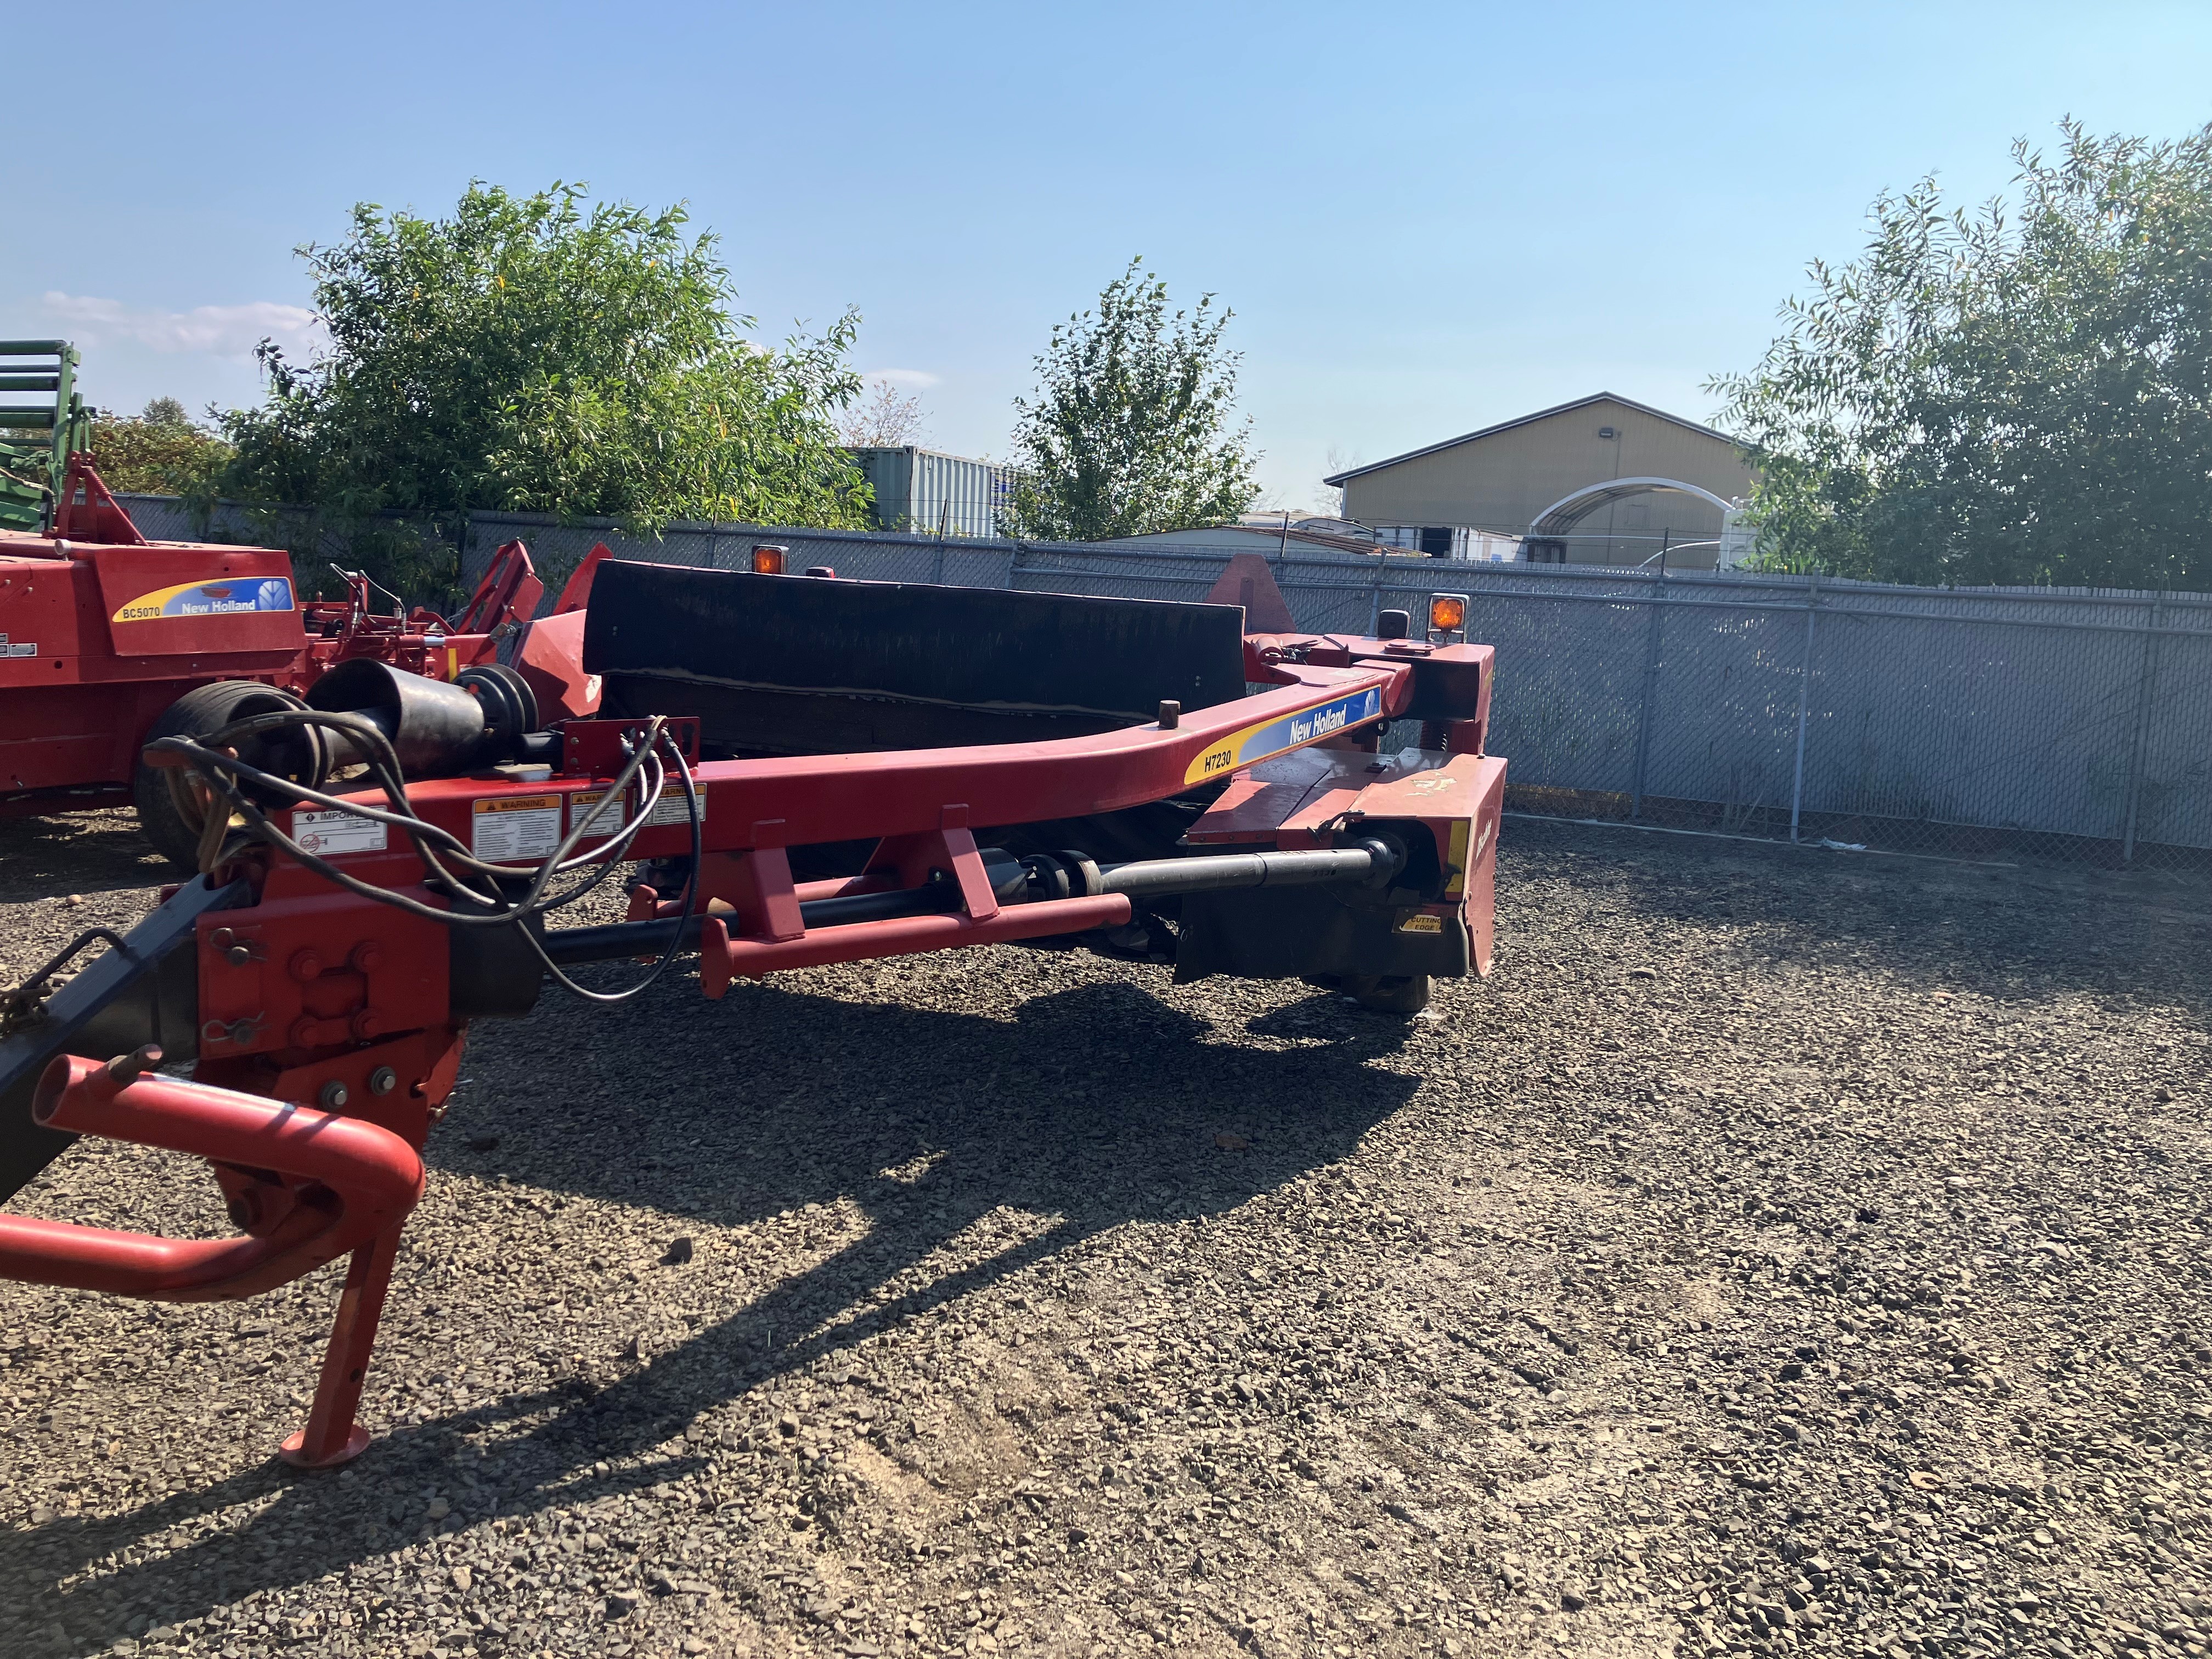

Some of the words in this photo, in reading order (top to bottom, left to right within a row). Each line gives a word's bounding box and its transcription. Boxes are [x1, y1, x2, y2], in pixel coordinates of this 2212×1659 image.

[123, 607, 160, 619] BC5070
[182, 603, 211, 614] New
[212, 599, 256, 612] Holland
[1290, 720, 1312, 744] New
[1312, 703, 1346, 737] Holland
[1205, 749, 1231, 772] H7230
[661, 786, 686, 795] ARNI
[501, 799, 546, 809] WARNING
